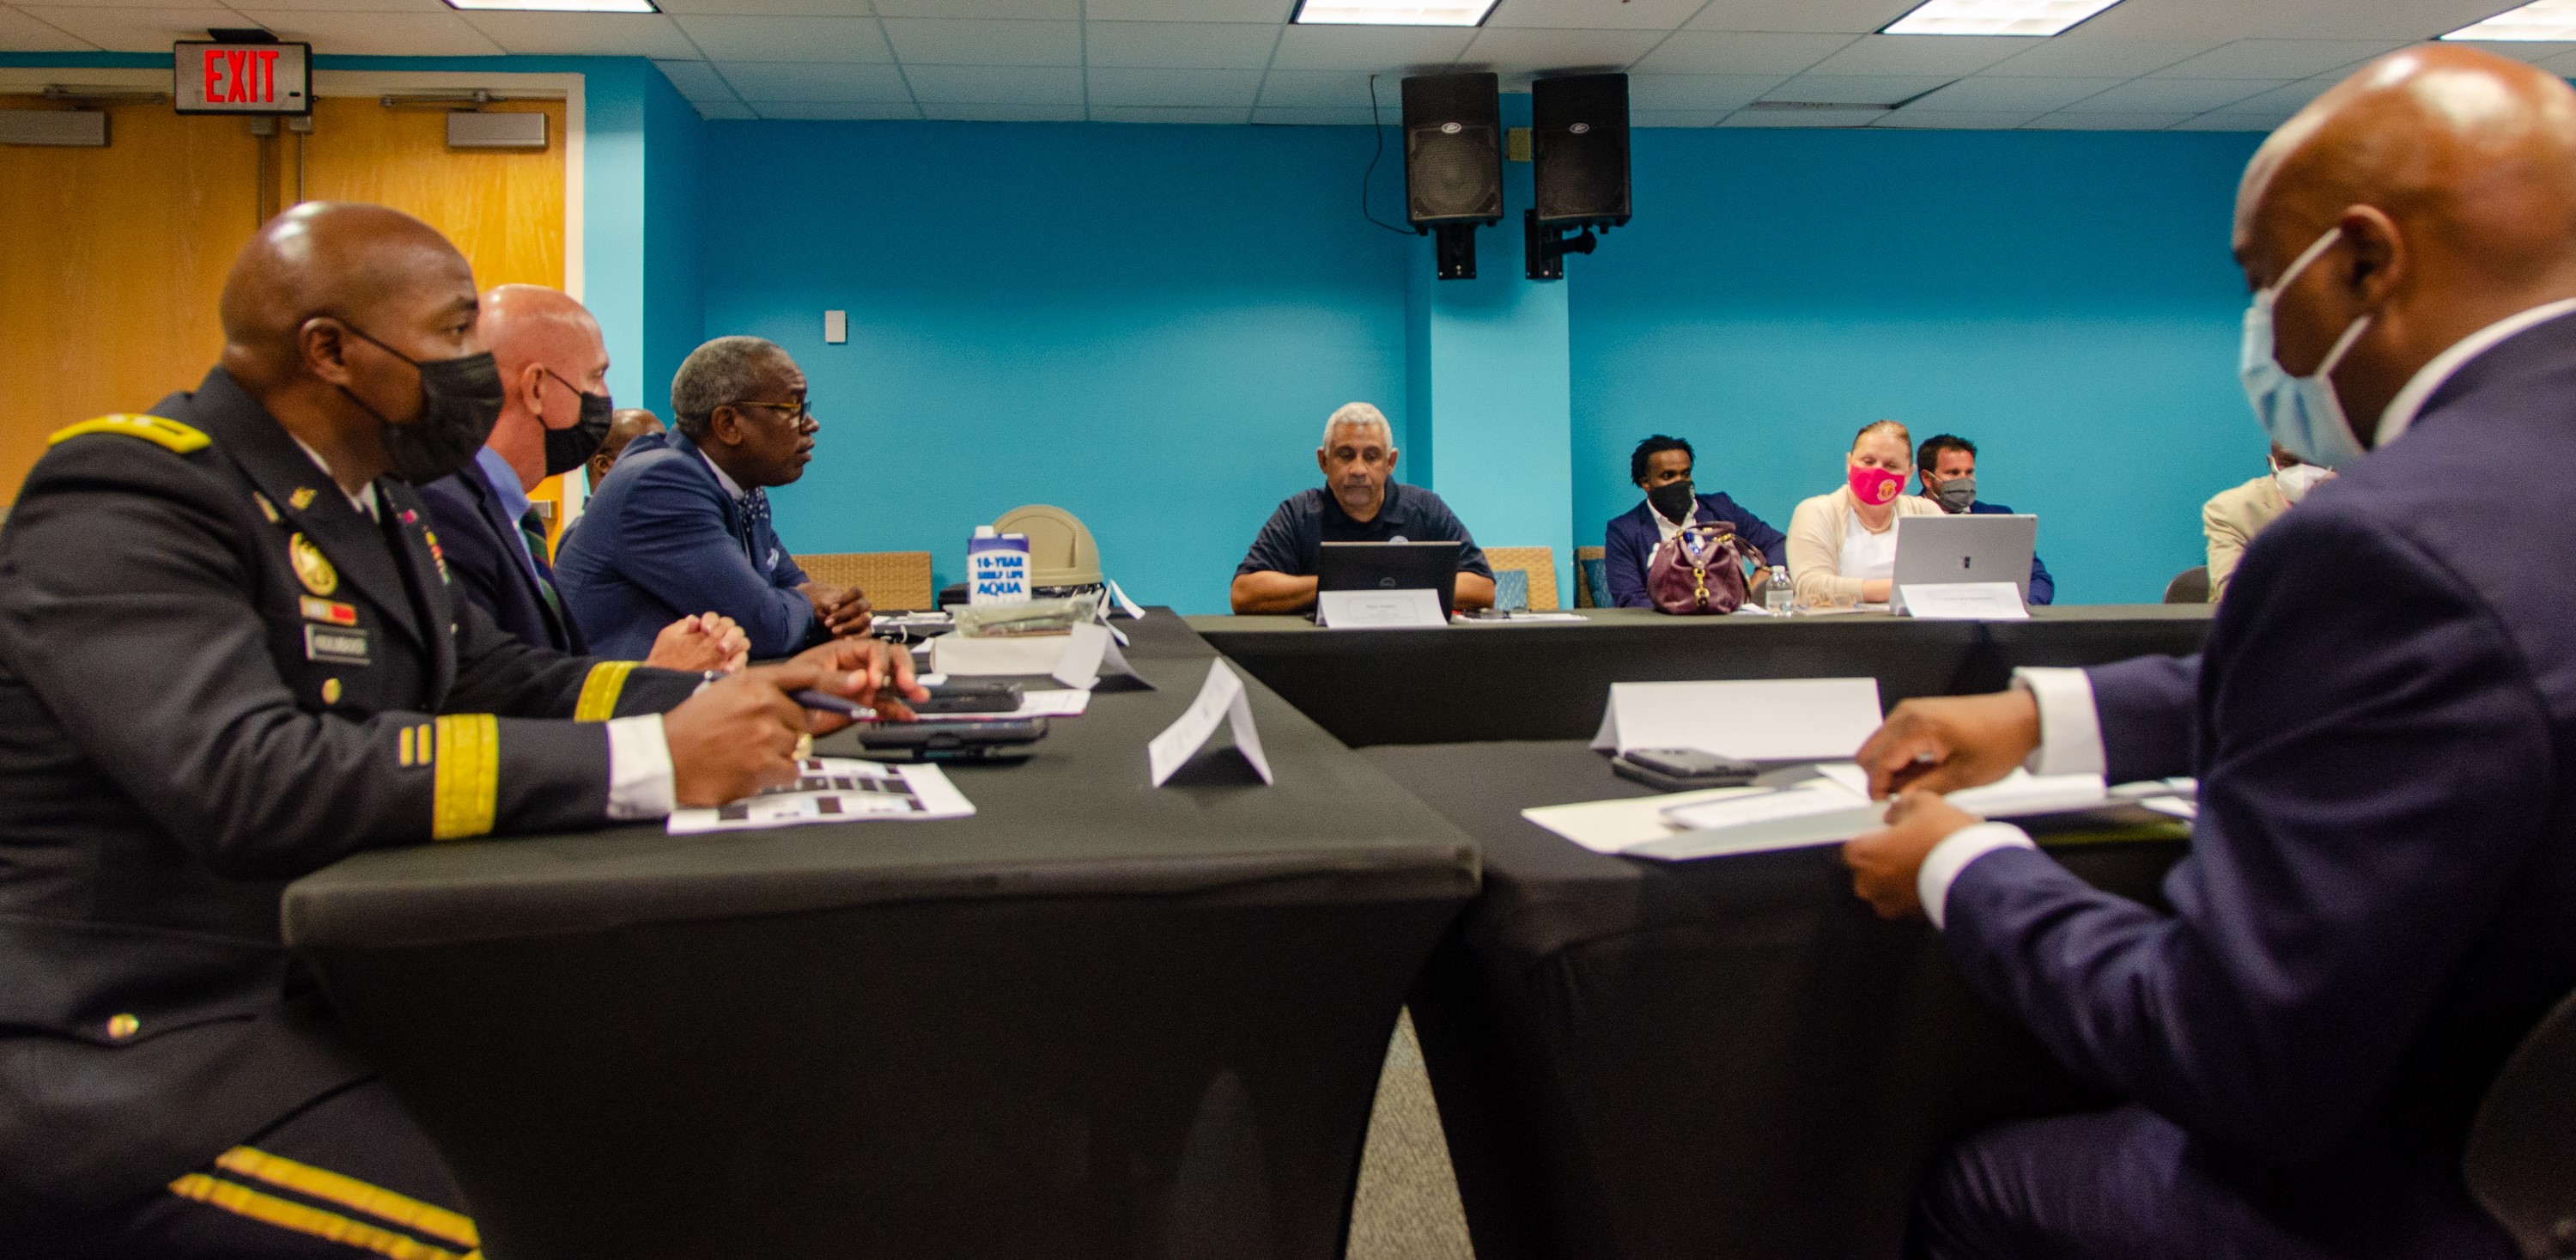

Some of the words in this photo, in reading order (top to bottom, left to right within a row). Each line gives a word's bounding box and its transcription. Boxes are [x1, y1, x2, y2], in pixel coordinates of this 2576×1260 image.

[204, 50, 279, 103] EXIT
[977, 556, 1023, 568] 10-YEAR
[977, 581, 1022, 596] AQUA
